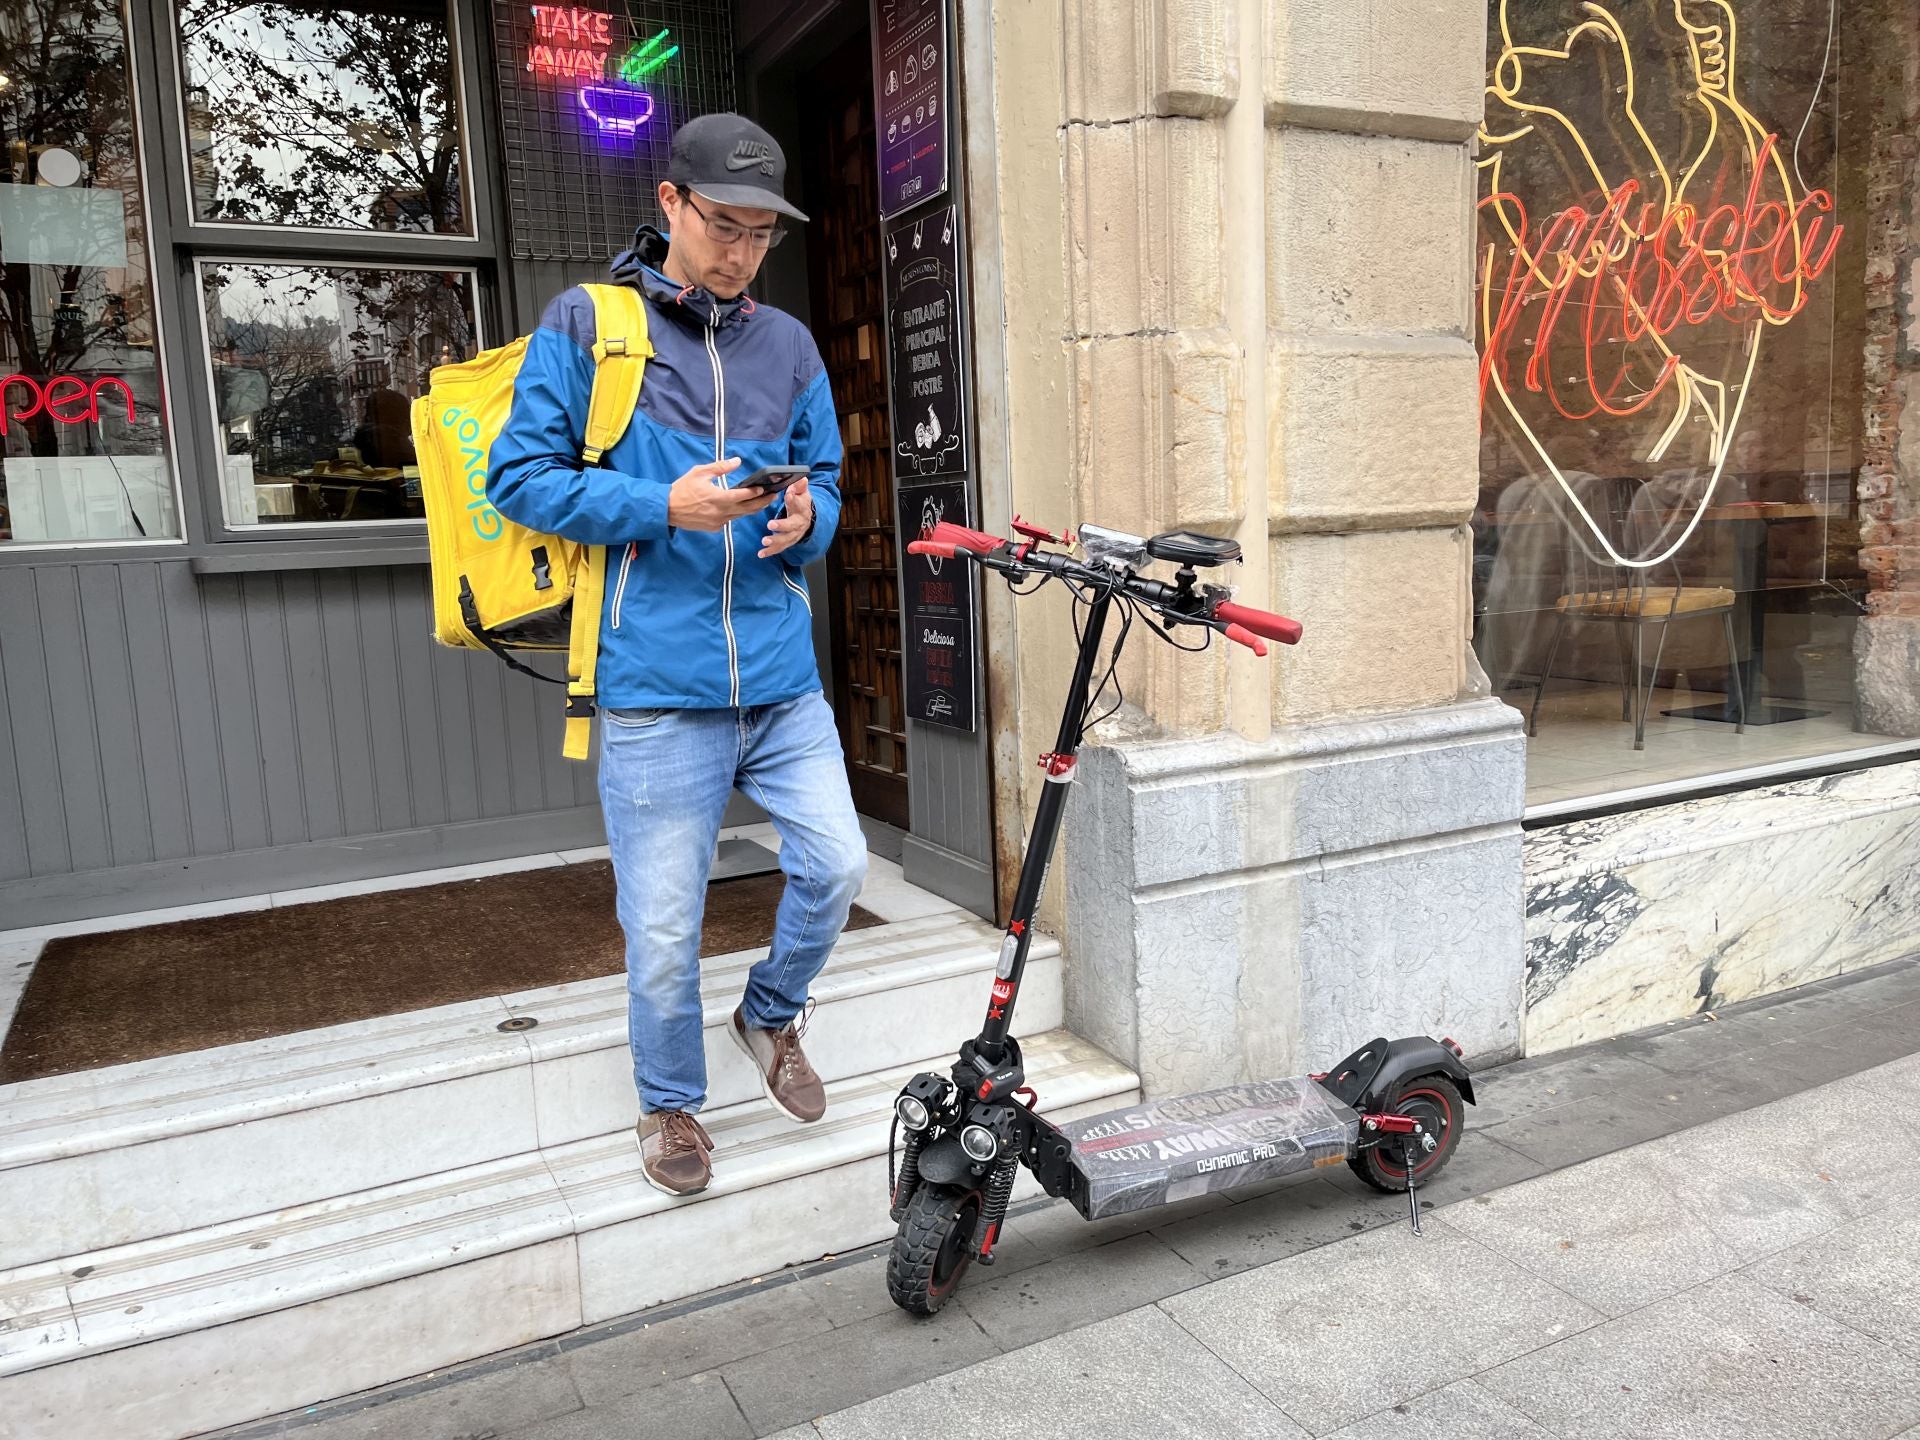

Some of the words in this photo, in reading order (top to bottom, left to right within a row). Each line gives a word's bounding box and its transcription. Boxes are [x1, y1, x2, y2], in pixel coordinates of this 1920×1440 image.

[531, 5, 613, 46] TAKE
[527, 45, 607, 84] AWAY
[735, 140, 769, 157] NIKE
[760, 162, 775, 176] SB
[903, 298, 945, 328] ENTRANTE
[904, 325, 946, 352] PRINCIPAL
[912, 350, 941, 373] BEBIDA
[913, 375, 943, 398] POSTRE
[923, 628, 955, 646] Deliciosa
[1197, 1150, 1249, 1174] DYNAMIC
[1252, 1144, 1277, 1163] PRO
